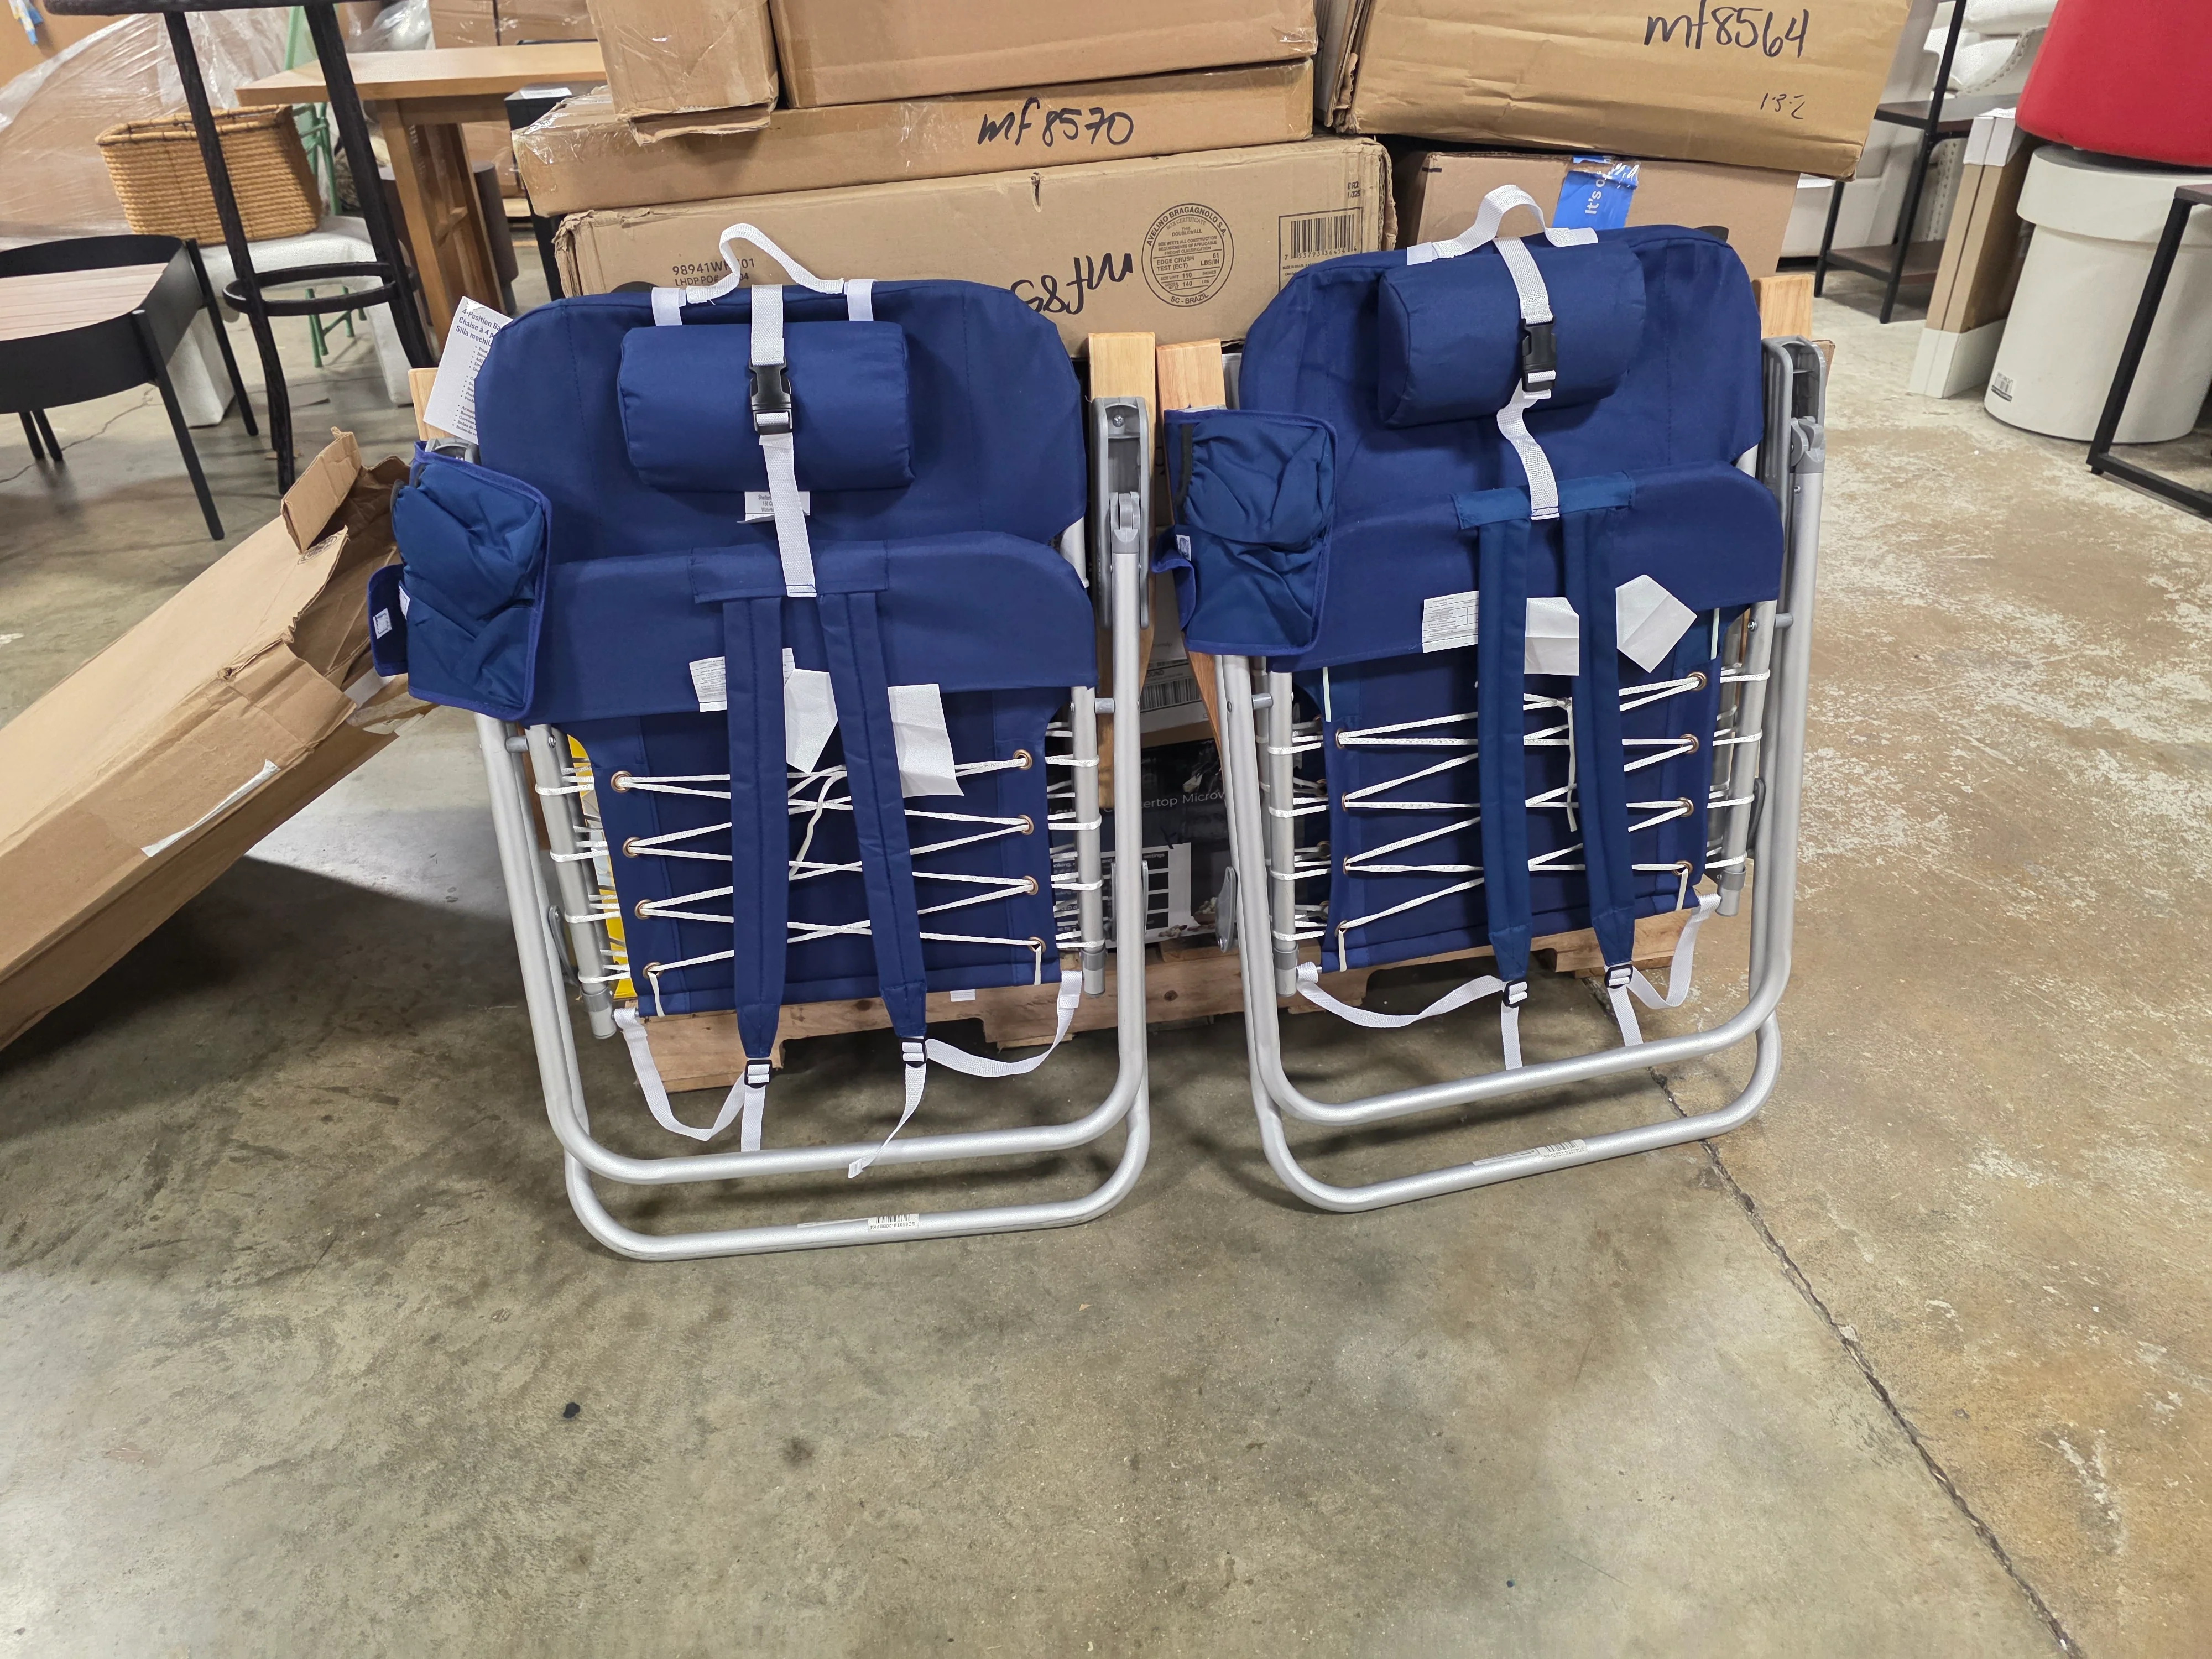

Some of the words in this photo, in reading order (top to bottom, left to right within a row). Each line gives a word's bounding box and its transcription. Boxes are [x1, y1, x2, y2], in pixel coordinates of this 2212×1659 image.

[1585, 191, 1602, 215] It's
[1146, 216, 1168, 246] AVELINO
[1169, 206, 1218, 223] BRAGAGNOLO
[1217, 221, 1227, 237] S.A.
[1166, 222, 1176, 230] BOX
[1176, 217, 1207, 226] CERTIFICATE
[1298, 251, 1320, 259] 53793
[1324, 247, 1345, 255] 36454
[672, 258, 755, 276] 98941W01
[1173, 263, 1188, 271] (ECT)
[675, 278, 699, 286] LHDP
[1185, 293, 1209, 304] BRAZIL
[459, 317, 478, 331] Chaise
[462, 309, 492, 327] 4-Position
[456, 325, 469, 336] Silla
